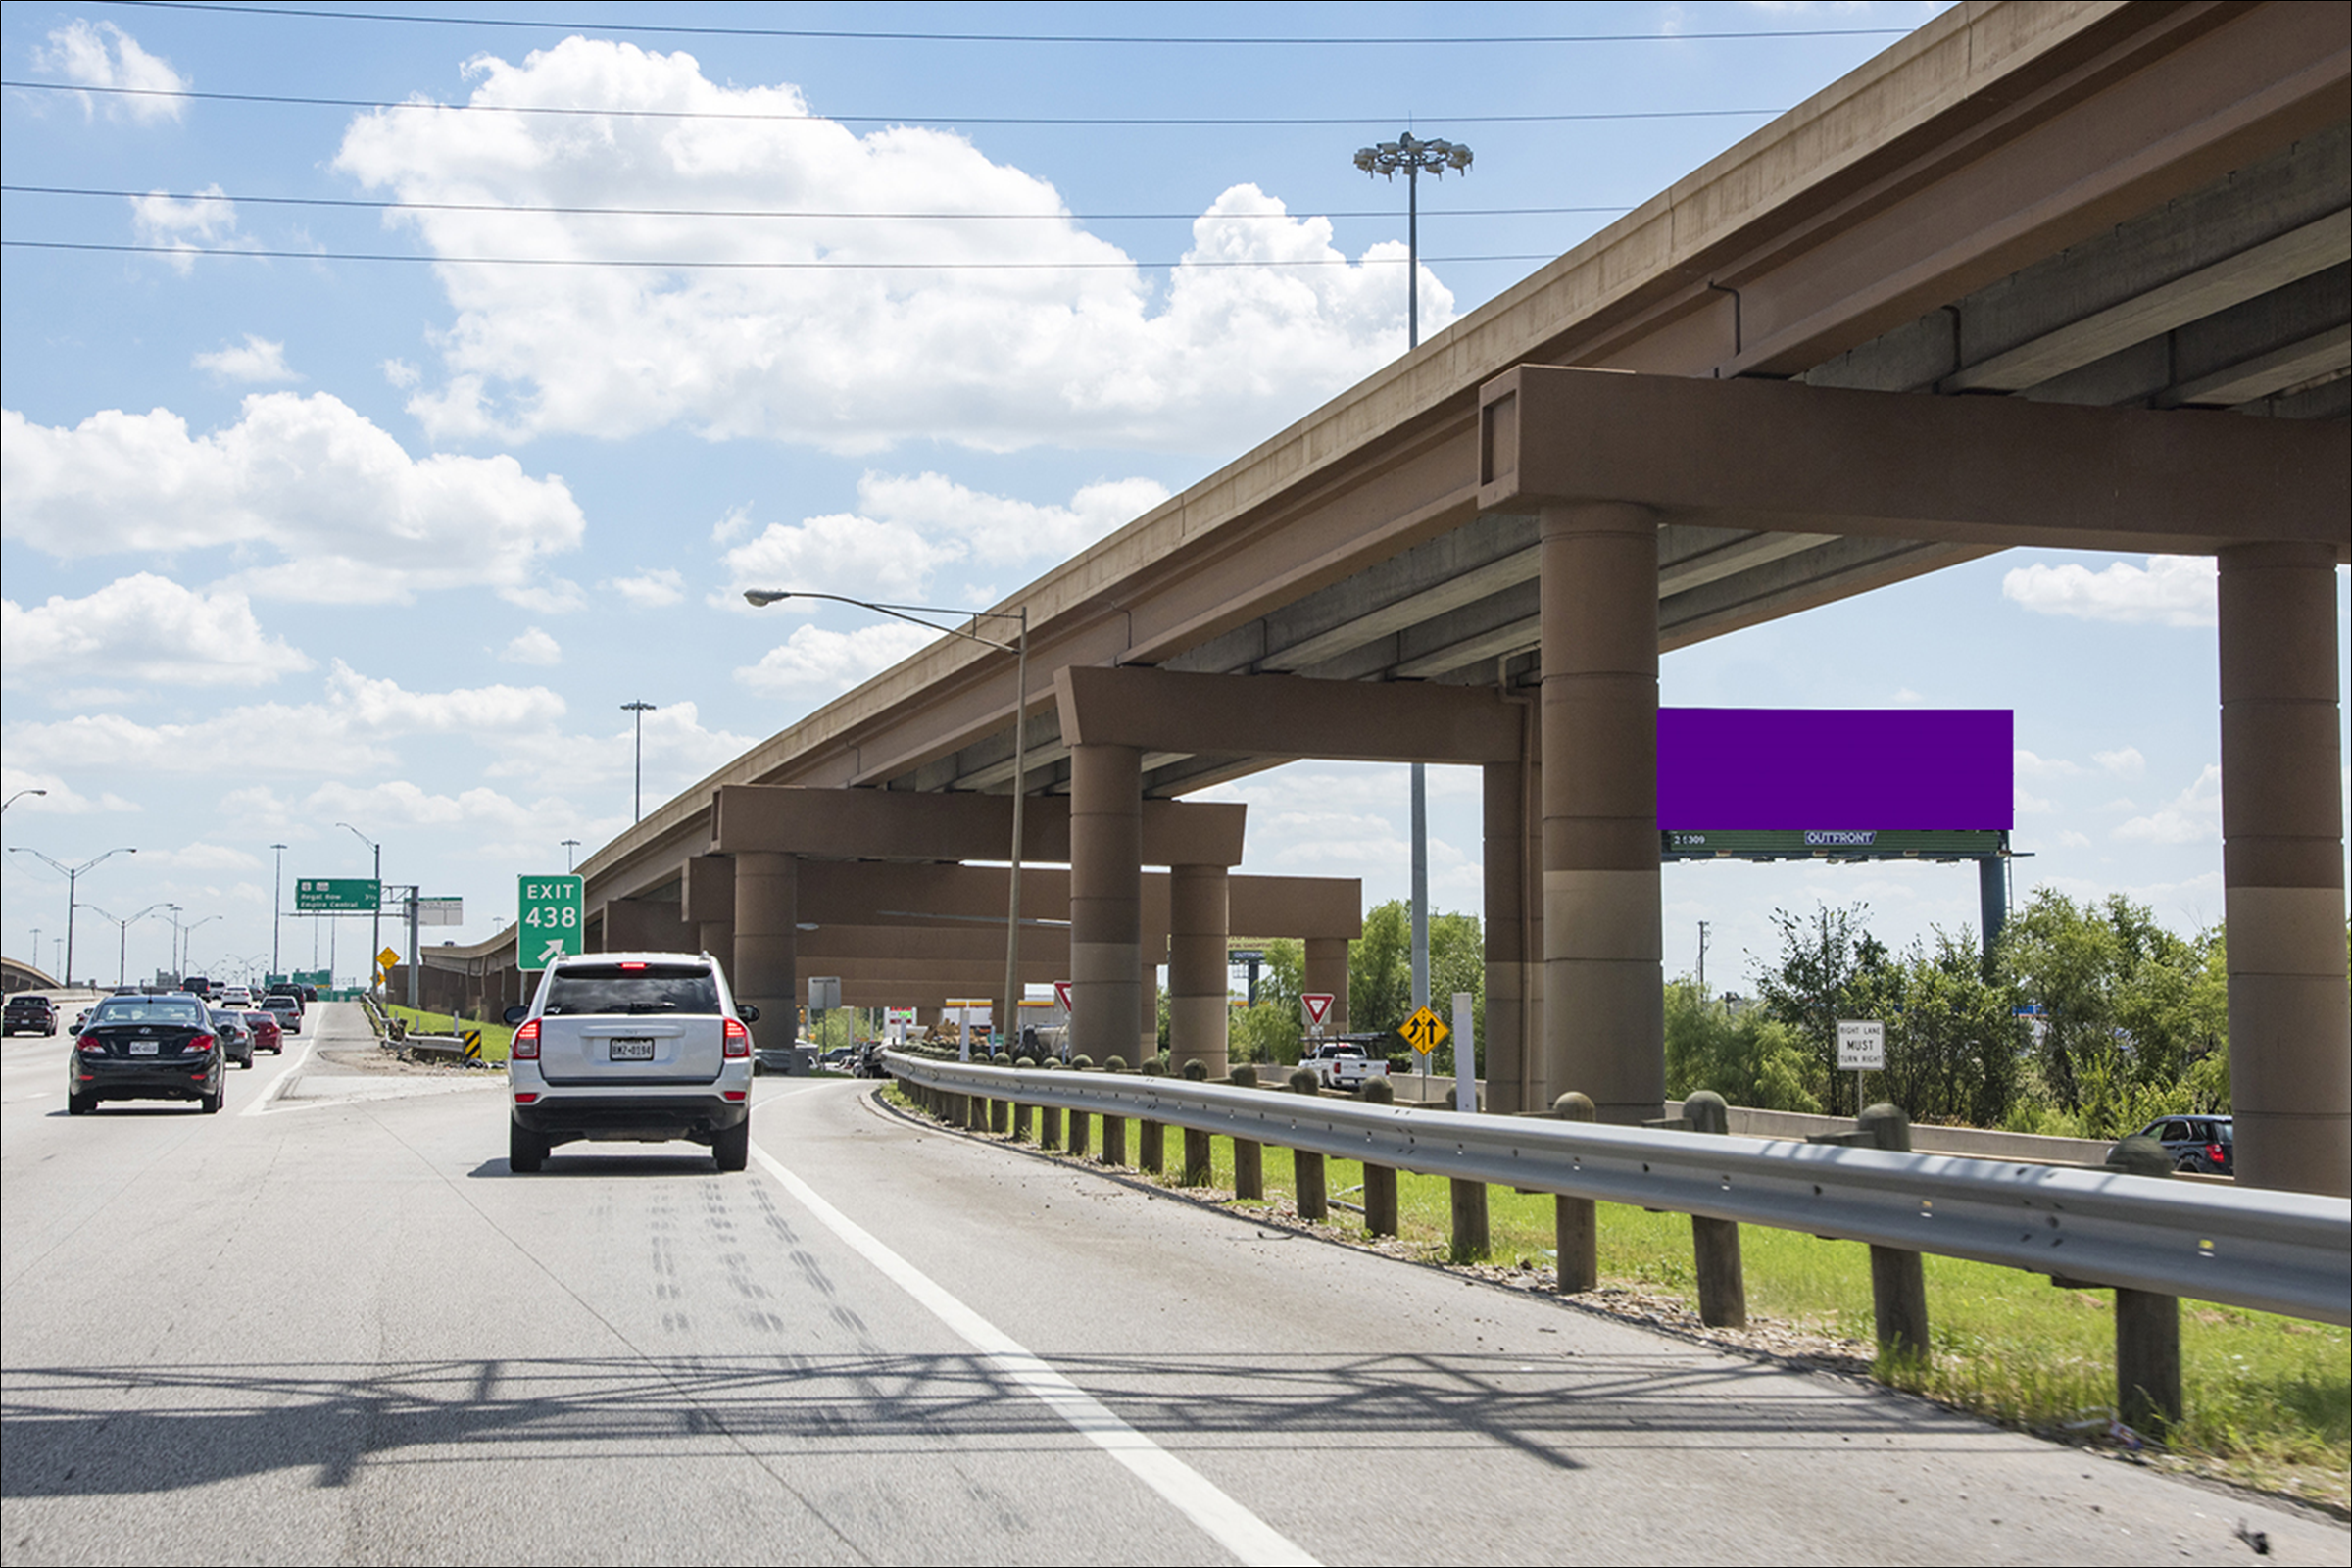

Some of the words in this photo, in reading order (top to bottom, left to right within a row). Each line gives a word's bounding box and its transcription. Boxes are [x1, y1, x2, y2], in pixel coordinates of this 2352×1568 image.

[1806, 832, 1874, 844] OUTFRONT
[527, 884, 574, 899] EXIT
[525, 906, 576, 928] 438
[1846, 1040, 1873, 1051] MUST
